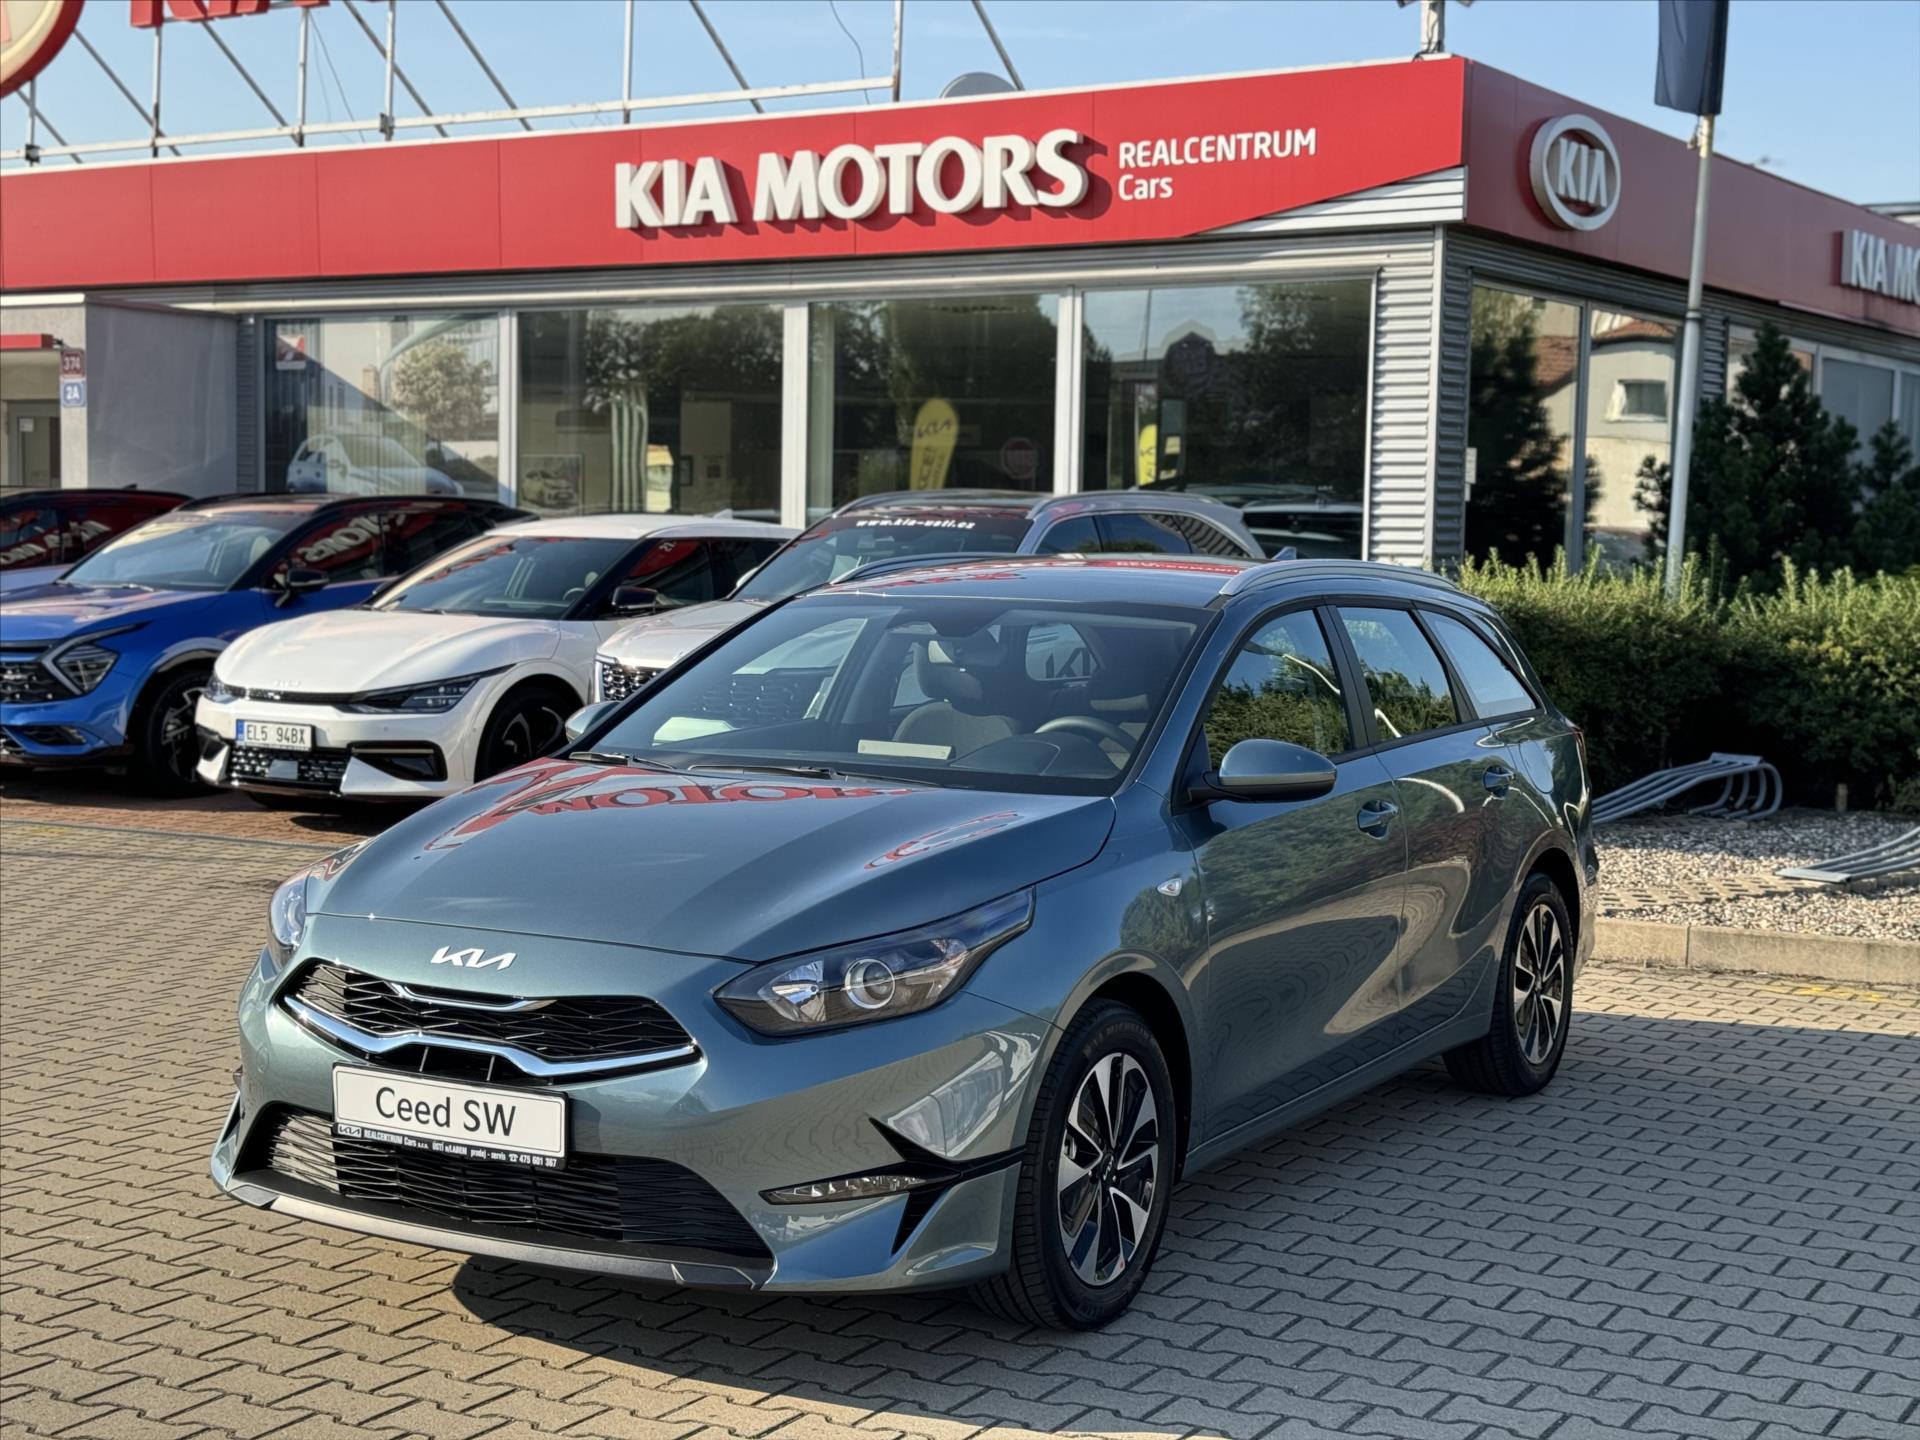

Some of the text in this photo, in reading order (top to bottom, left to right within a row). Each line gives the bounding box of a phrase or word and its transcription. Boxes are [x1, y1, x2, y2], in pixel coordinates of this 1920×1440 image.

[1119, 128, 1316, 169] REALCENTRUM
[615, 128, 1088, 228] KIA MOTORS
[1118, 174, 1173, 200] Cars
[1557, 138, 1608, 208] KIA
[1846, 229, 1889, 296] KIA
[63, 356, 81, 371] 374
[66, 385, 80, 400] 2A
[246, 724, 305, 745] EL5 94BX
[430, 945, 517, 971] KIA
[376, 1086, 516, 1137] Ceed SW
[364, 1129, 403, 1144] REALCENTRUM
[404, 1137, 417, 1147] Cars
[519, 1154, 531, 1165] 475
[532, 1156, 544, 1166] 601
